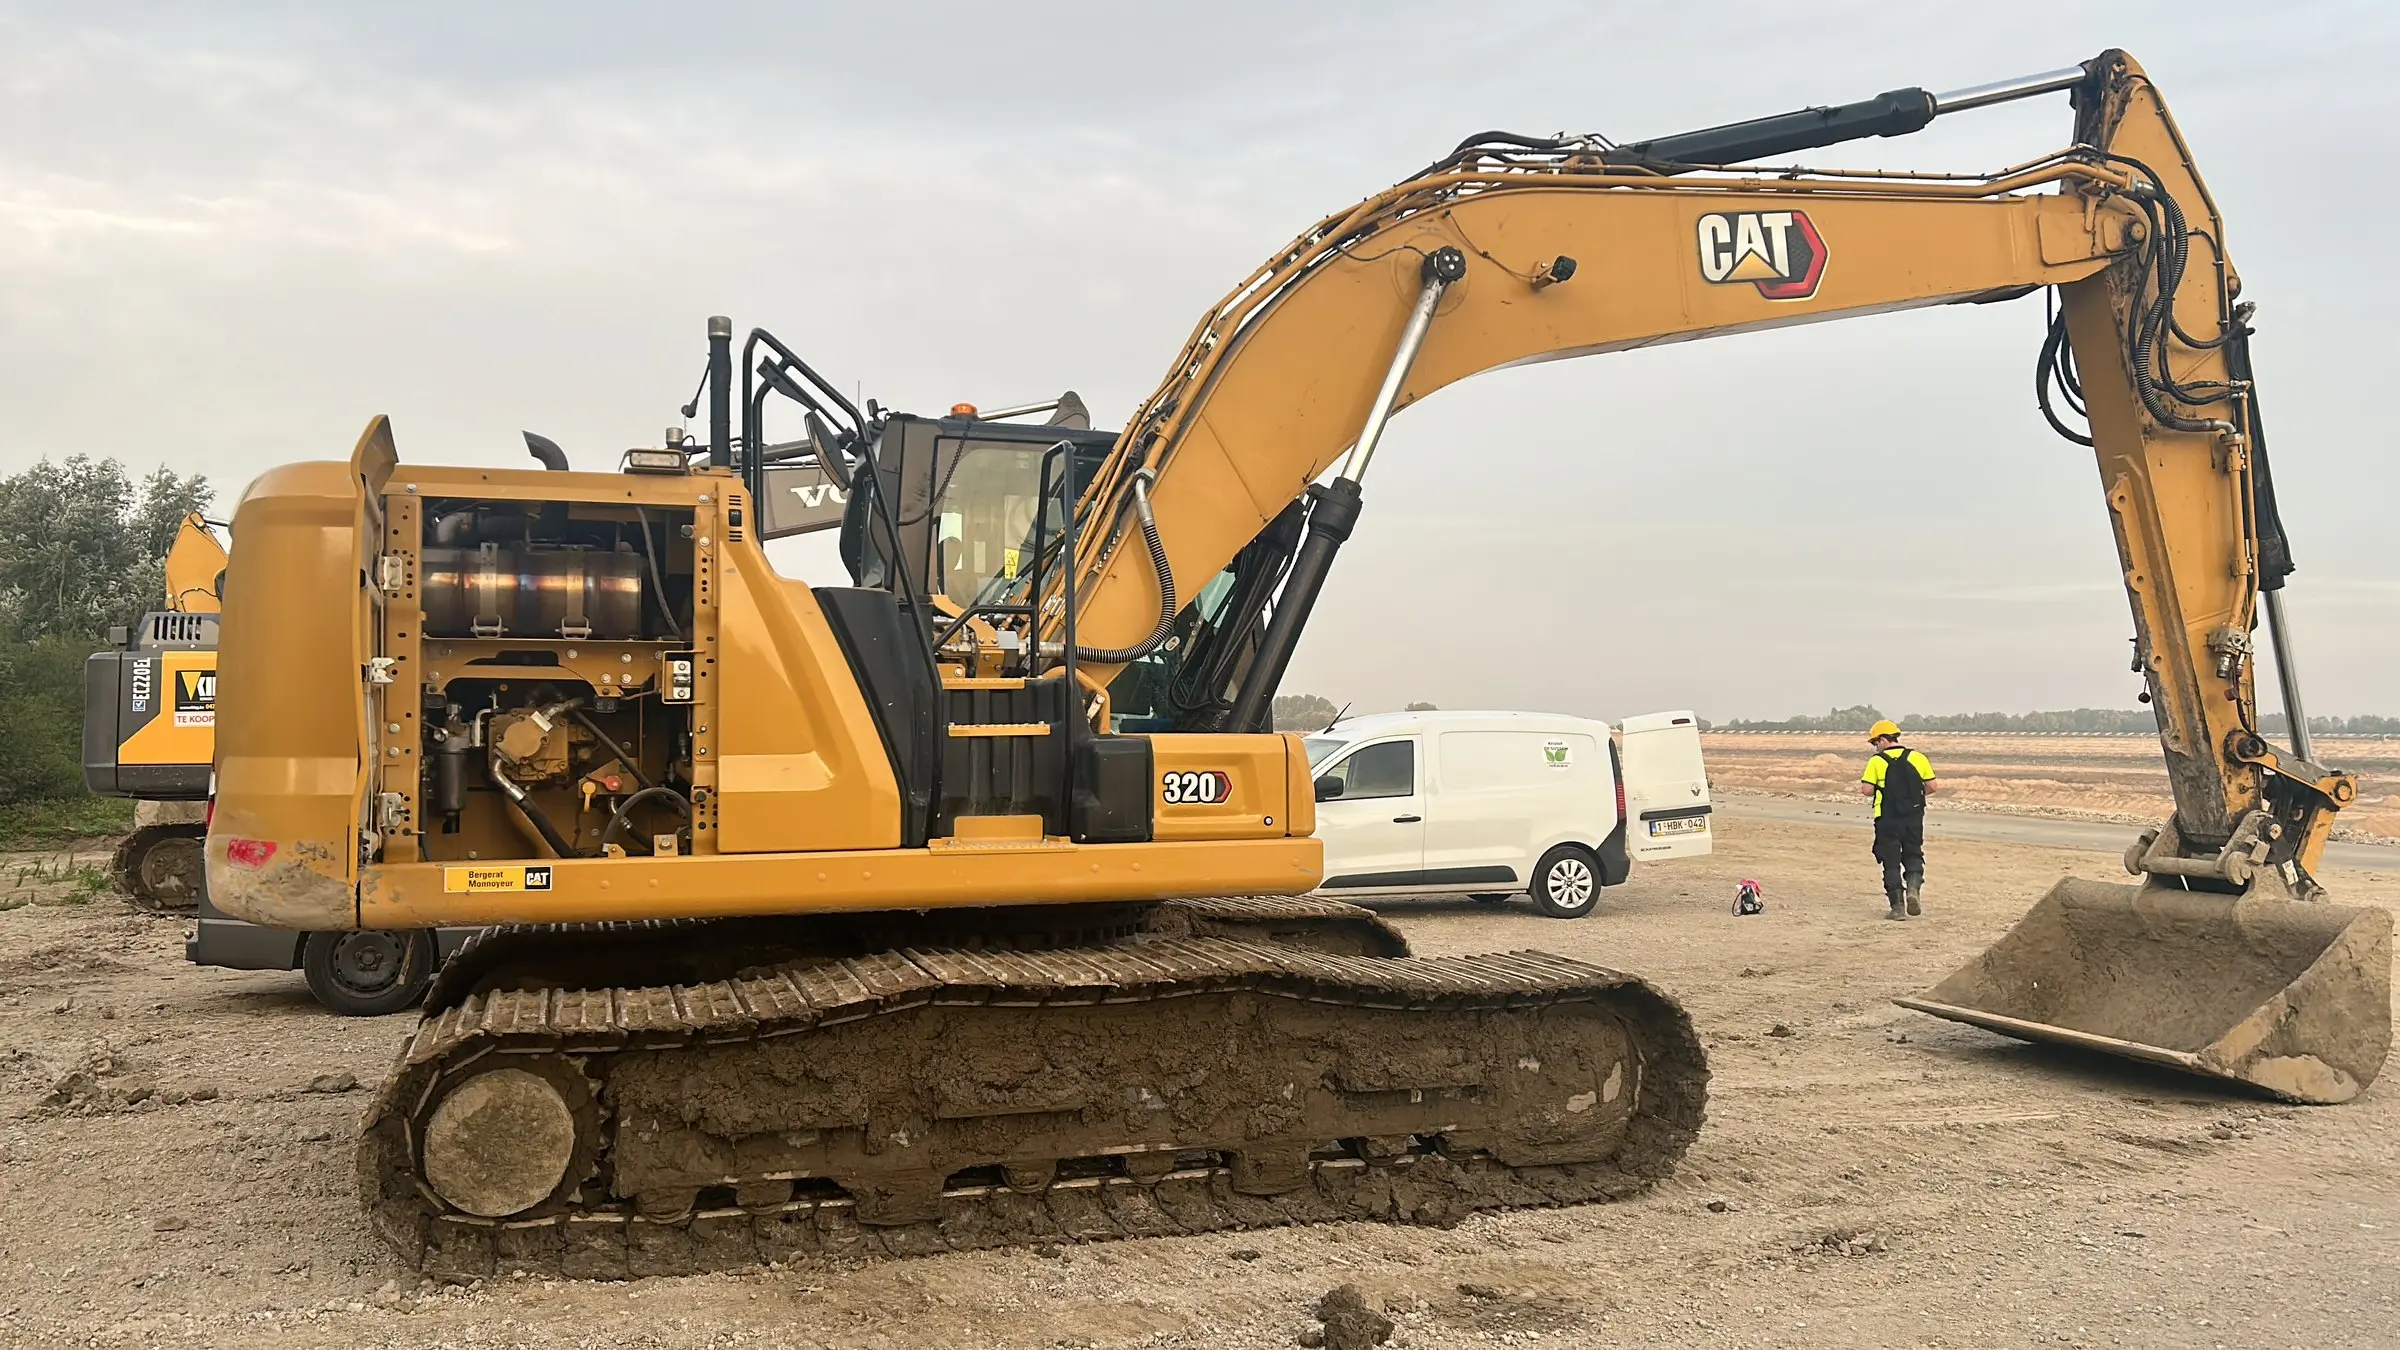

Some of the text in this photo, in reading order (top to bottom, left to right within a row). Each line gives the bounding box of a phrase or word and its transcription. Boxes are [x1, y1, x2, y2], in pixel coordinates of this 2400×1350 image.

[1698, 212, 1793, 282] CAT
[176, 715, 215, 723] TE KOOP
[1163, 772, 1216, 803] 320
[468, 870, 504, 880] Bergerat
[526, 872, 550, 887] CAT
[468, 880, 514, 888] Monnoyeur
